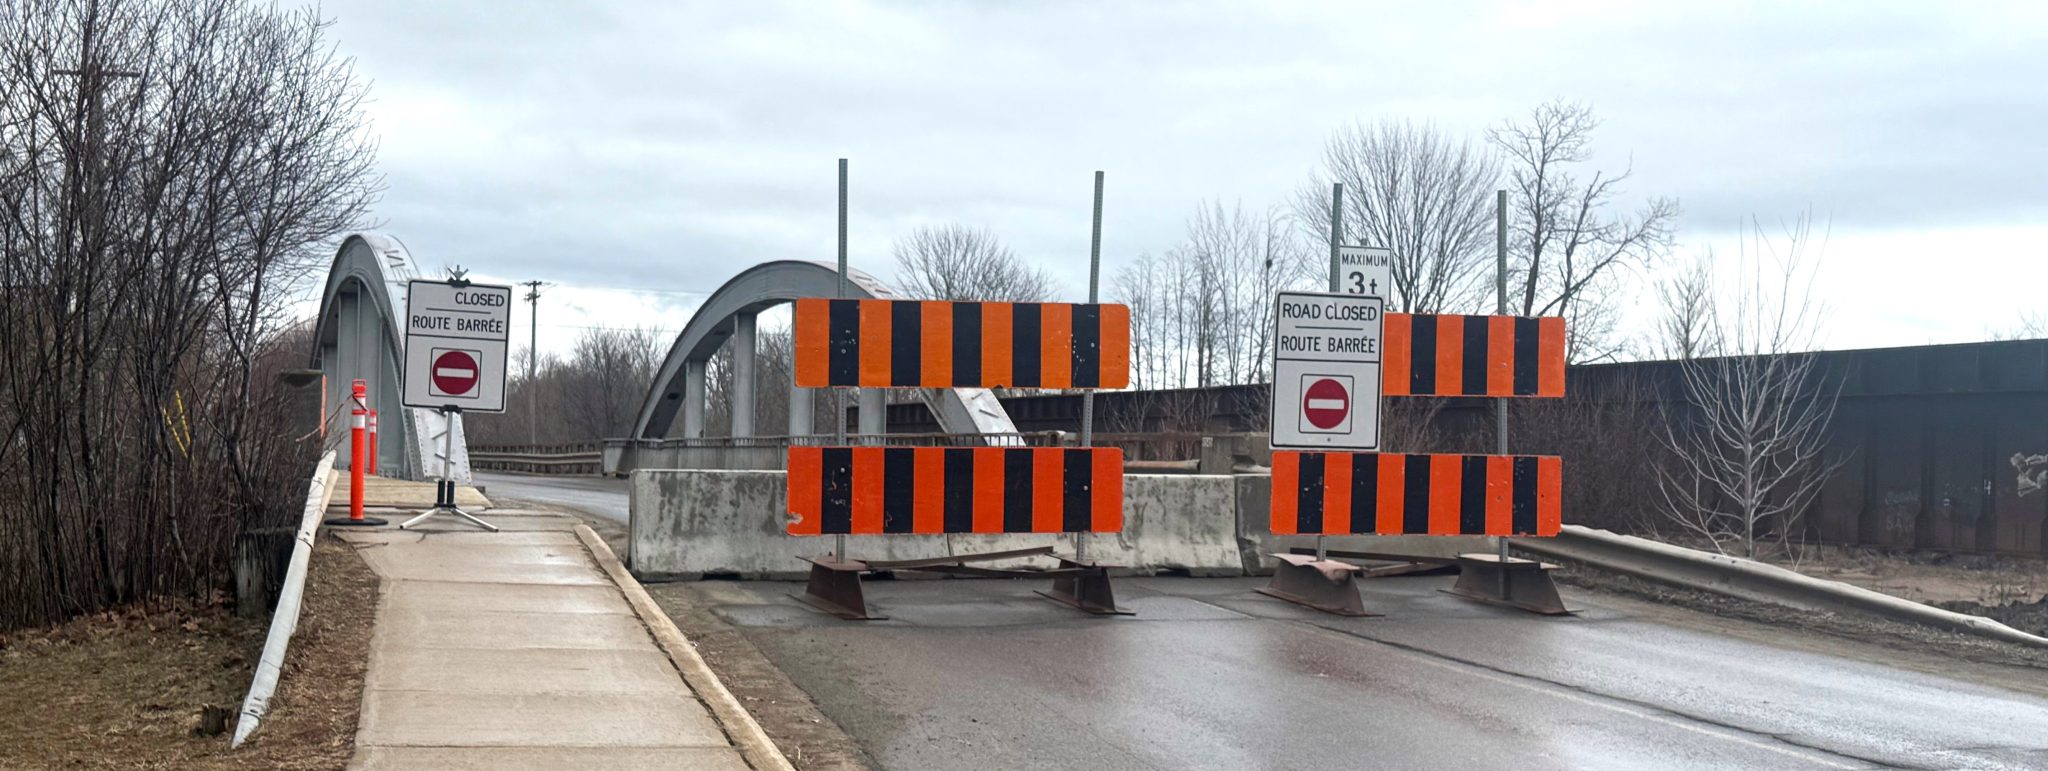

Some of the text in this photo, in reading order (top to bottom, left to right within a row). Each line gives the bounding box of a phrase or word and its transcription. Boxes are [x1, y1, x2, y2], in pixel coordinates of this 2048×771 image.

[1341, 253, 1388, 267] MAXIMUM
[455, 291, 505, 307] CLOSED
[1282, 303, 1377, 321] ROAD CLOSED
[412, 315, 503, 334] ROUTE BARRÉE
[1281, 335, 1376, 354] ROUTE BARRÉE
